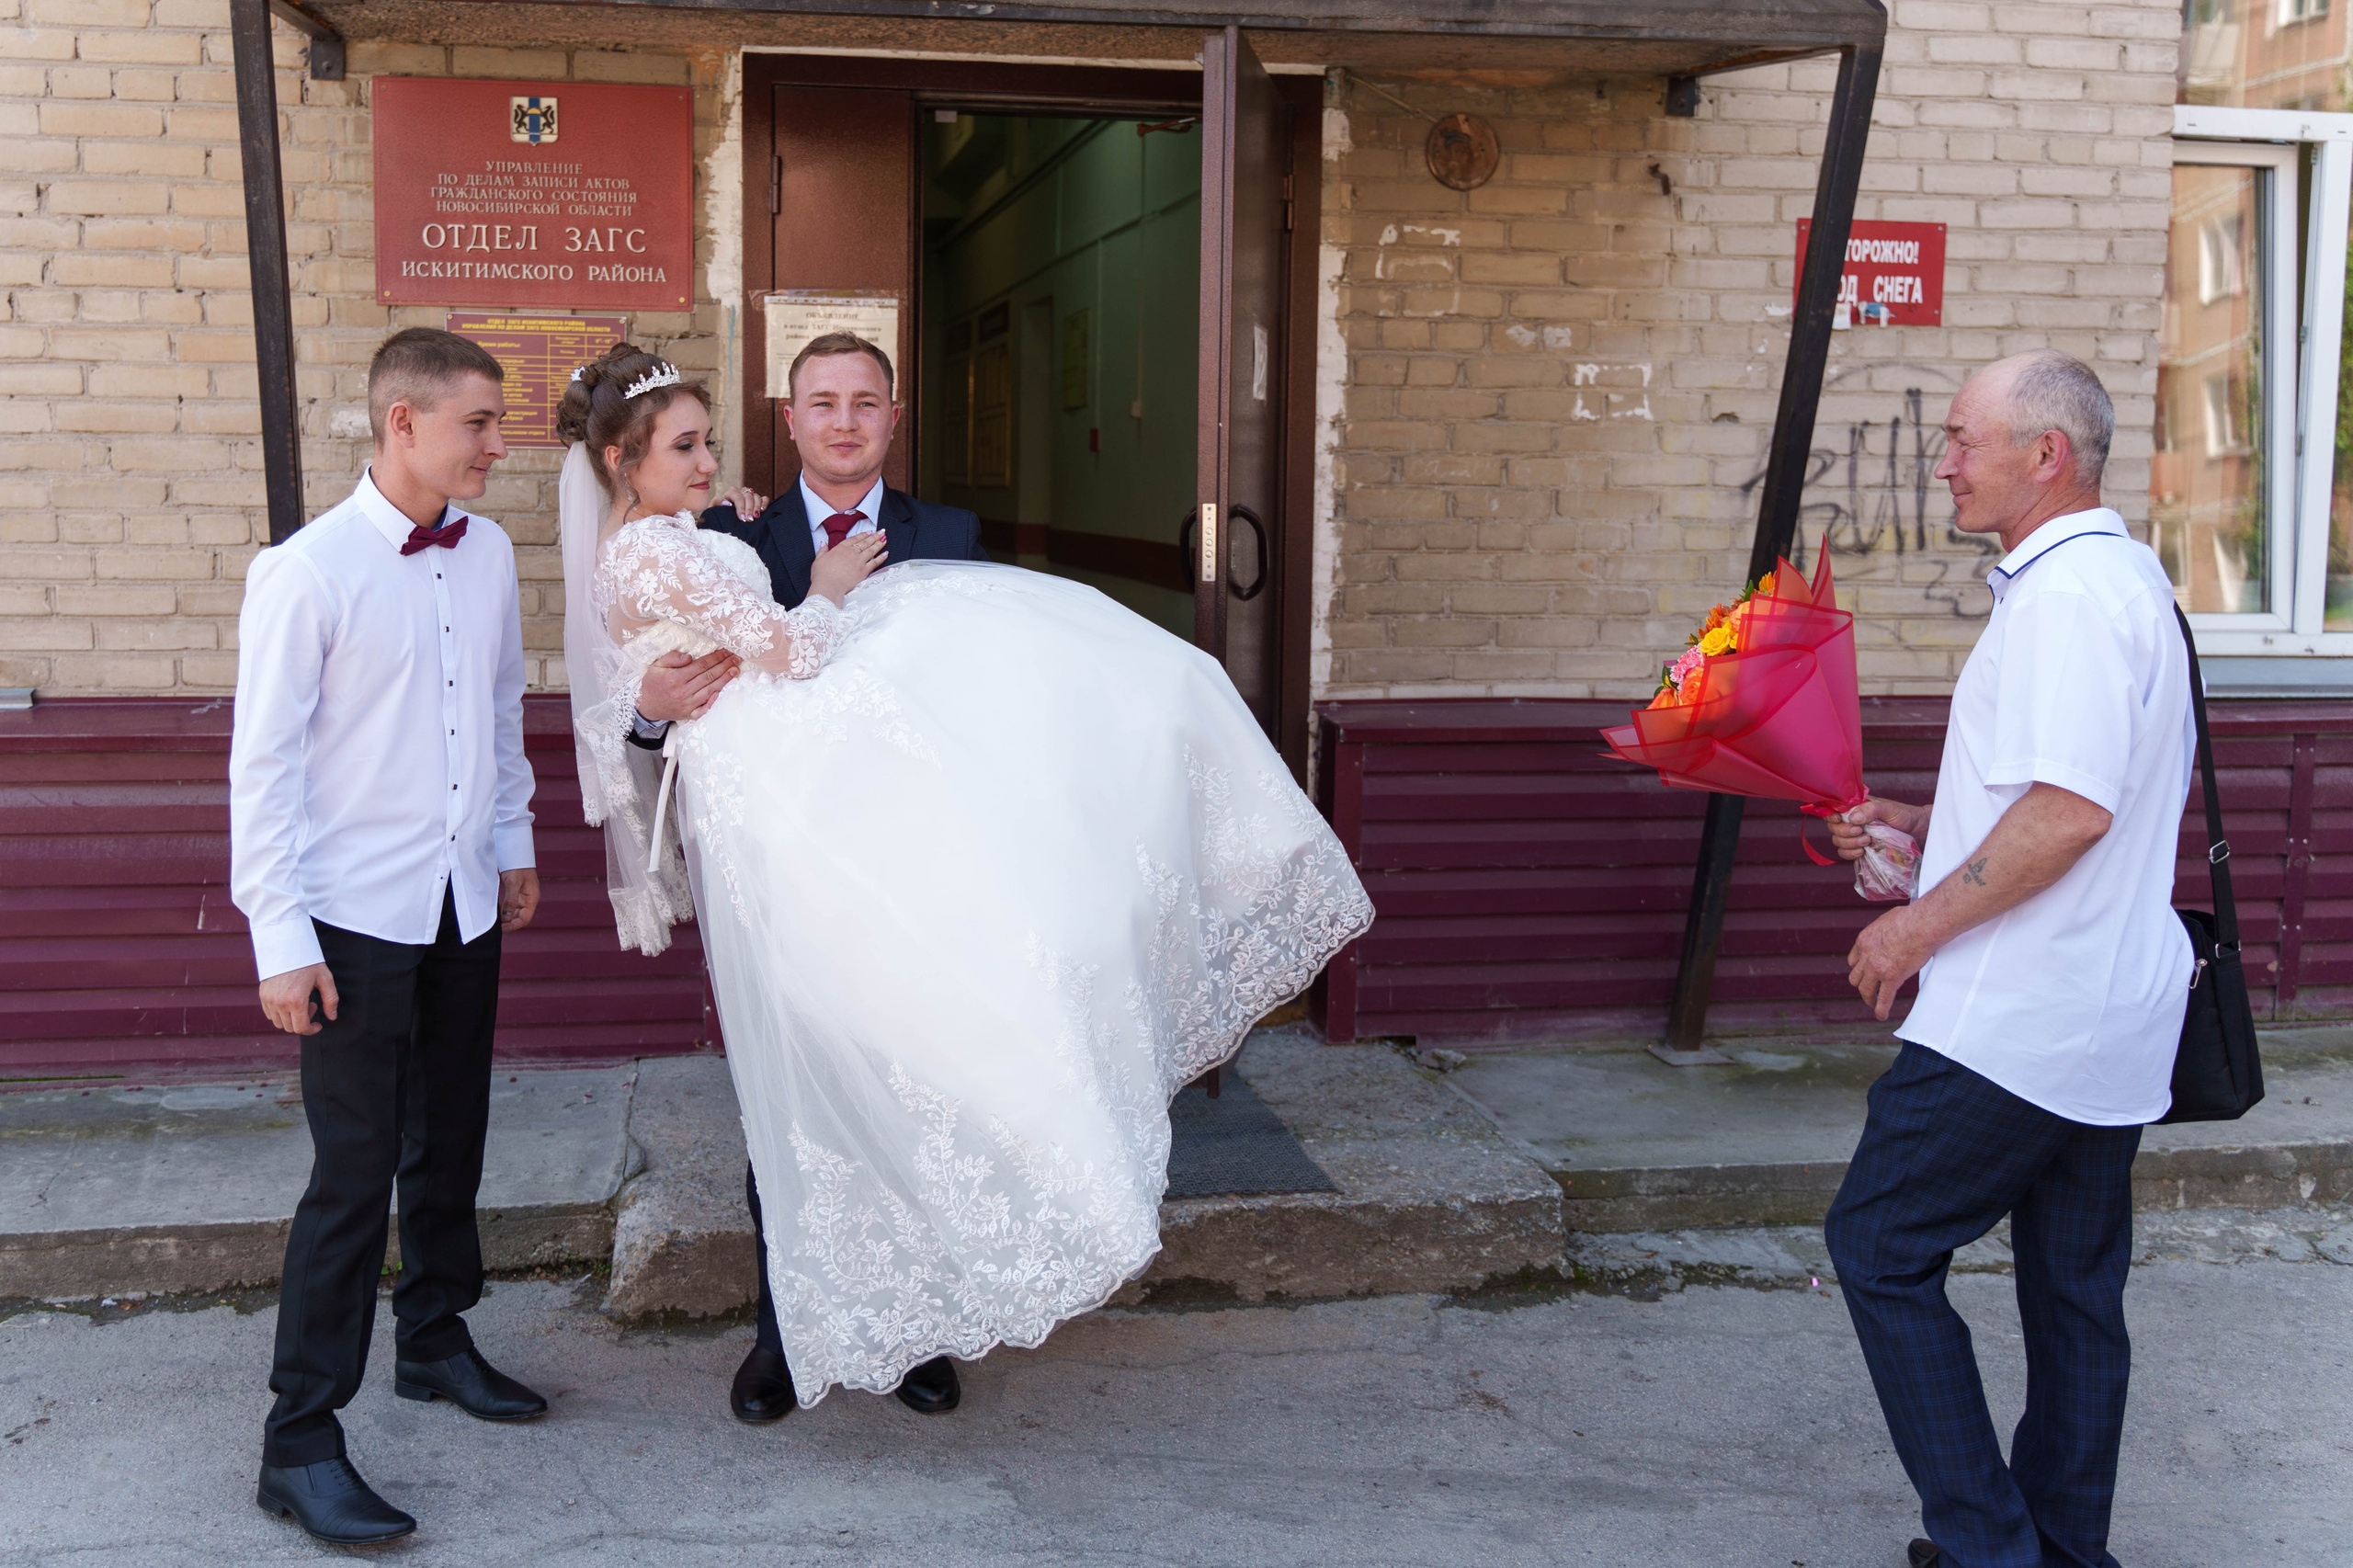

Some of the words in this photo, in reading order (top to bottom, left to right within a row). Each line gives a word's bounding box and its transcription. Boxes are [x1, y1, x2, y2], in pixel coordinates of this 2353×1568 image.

[485, 161, 584, 175] УПРАВЛЕНИЕ
[438, 174, 459, 185] ПО
[464, 175, 515, 187] ДЕЛАМ
[522, 176, 578, 188] ЗАПИСИ
[585, 178, 631, 189] АКТОВ
[430, 187, 543, 200] ГРАЖДАНСКОГО
[551, 190, 637, 203] СОСТОЯНИЯ
[437, 200, 561, 215] НОВОСИБИРСКОЙ
[568, 204, 632, 217] ОБЛАСТИ
[422, 223, 538, 253] ОТДЕЛ
[564, 227, 646, 253] ЗАГС
[1844, 238, 1919, 264] ТОРОЖНО!
[402, 261, 574, 281] ИСКИТИМСКОГО
[588, 264, 666, 282] РАЙОНА
[1873, 275, 1923, 303] СНЕГА
